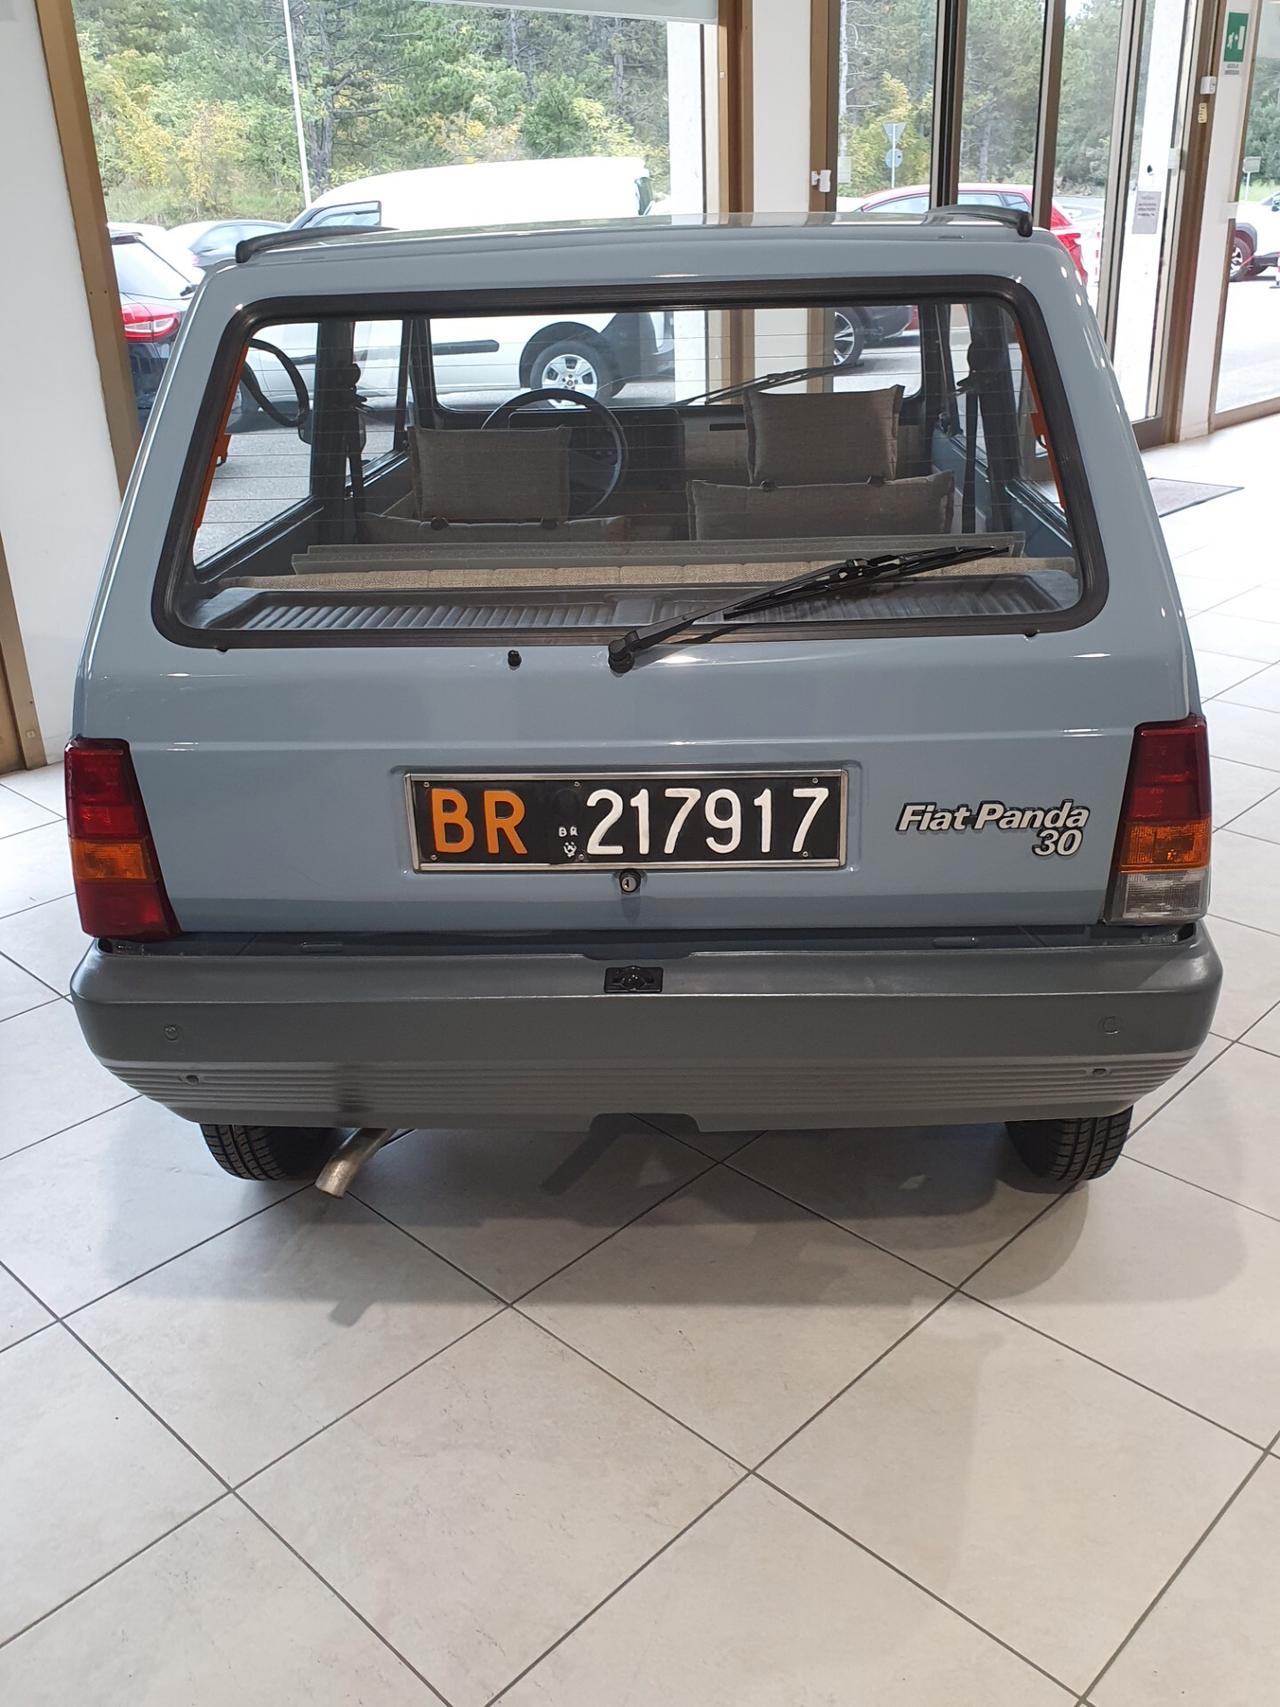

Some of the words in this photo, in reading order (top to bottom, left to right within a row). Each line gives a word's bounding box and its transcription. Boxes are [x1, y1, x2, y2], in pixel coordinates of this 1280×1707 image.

[431, 788, 528, 855] BR
[585, 787, 830, 855] 217917
[897, 802, 973, 832] Fiat
[972, 799, 1091, 832] Panda
[558, 826, 578, 837] BR
[1033, 828, 1083, 858] 30
